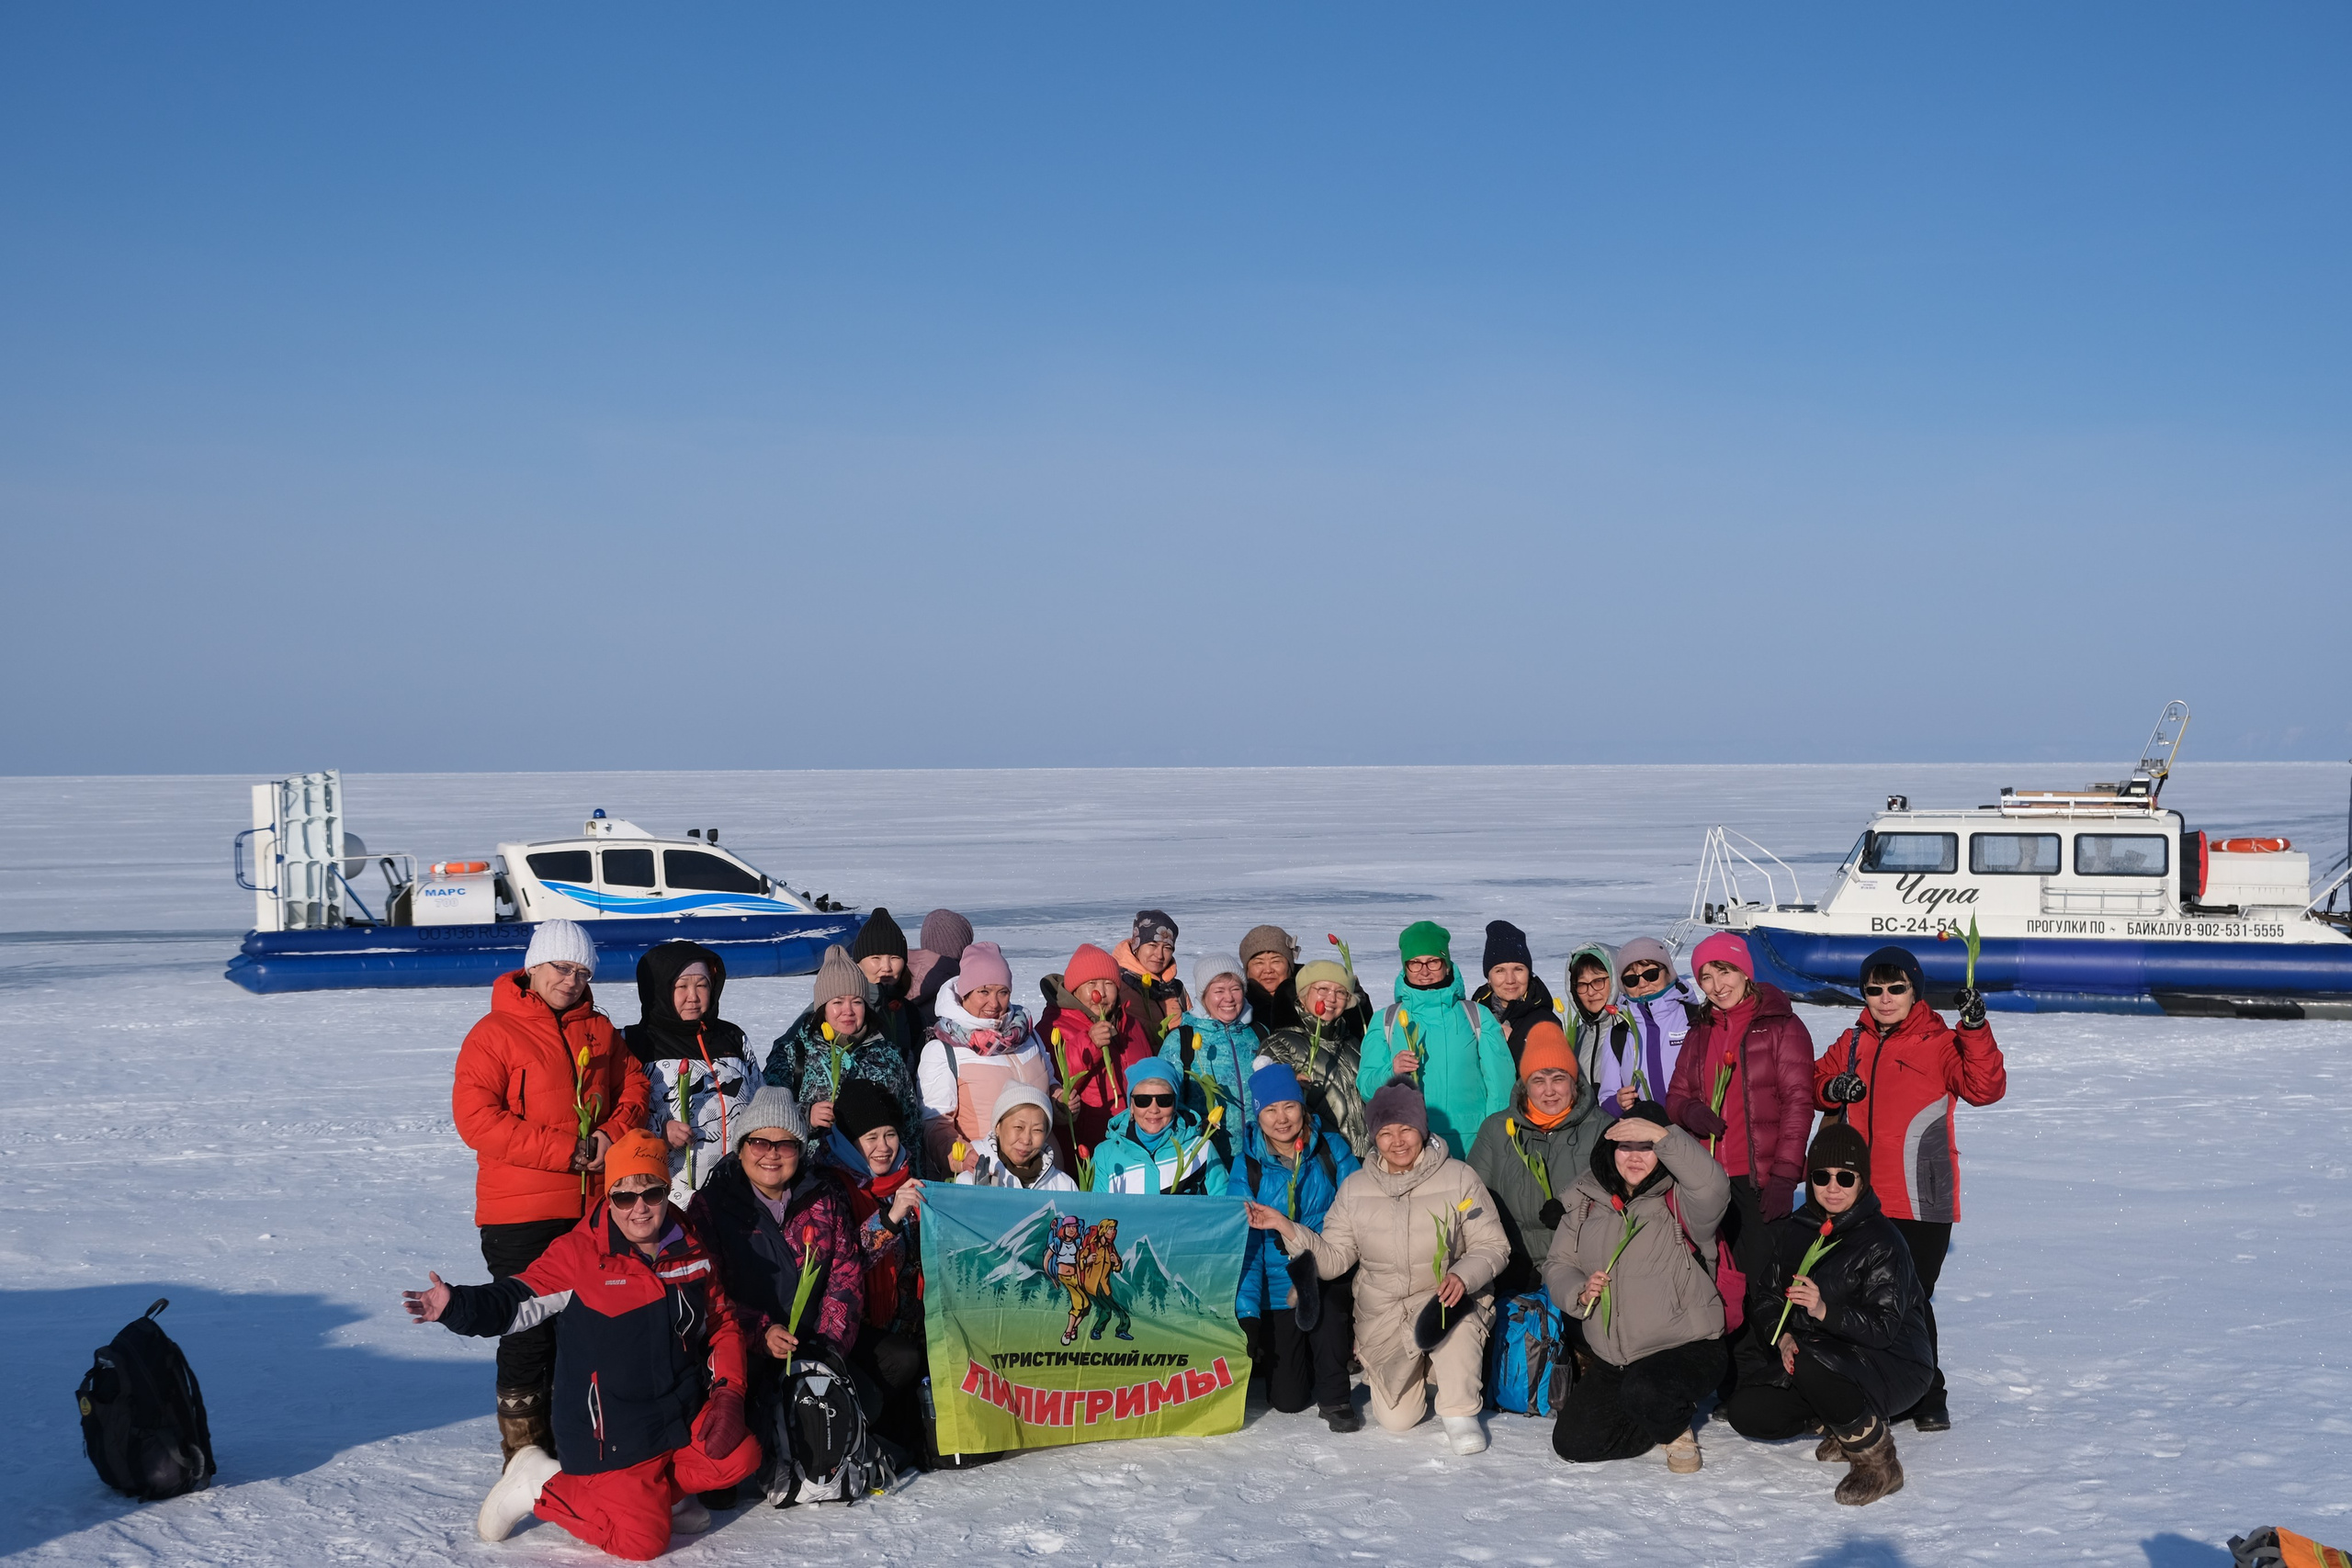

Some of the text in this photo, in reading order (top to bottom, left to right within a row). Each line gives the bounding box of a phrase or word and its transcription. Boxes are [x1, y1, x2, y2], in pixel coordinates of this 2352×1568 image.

[425, 888, 466, 897] МАРС
[1895, 874, 1980, 914] Чара
[435, 898, 459, 908] 700
[2027, 919, 2285, 937] ПРОГУЛКИ ПО БАЙКАЛУ 8-902-531-5555
[991, 1349, 1189, 1369] ТУРИСТИЧЕСКИЙ КЛУБ
[960, 1356, 1234, 1427] ПИЛИГРИМЫ
